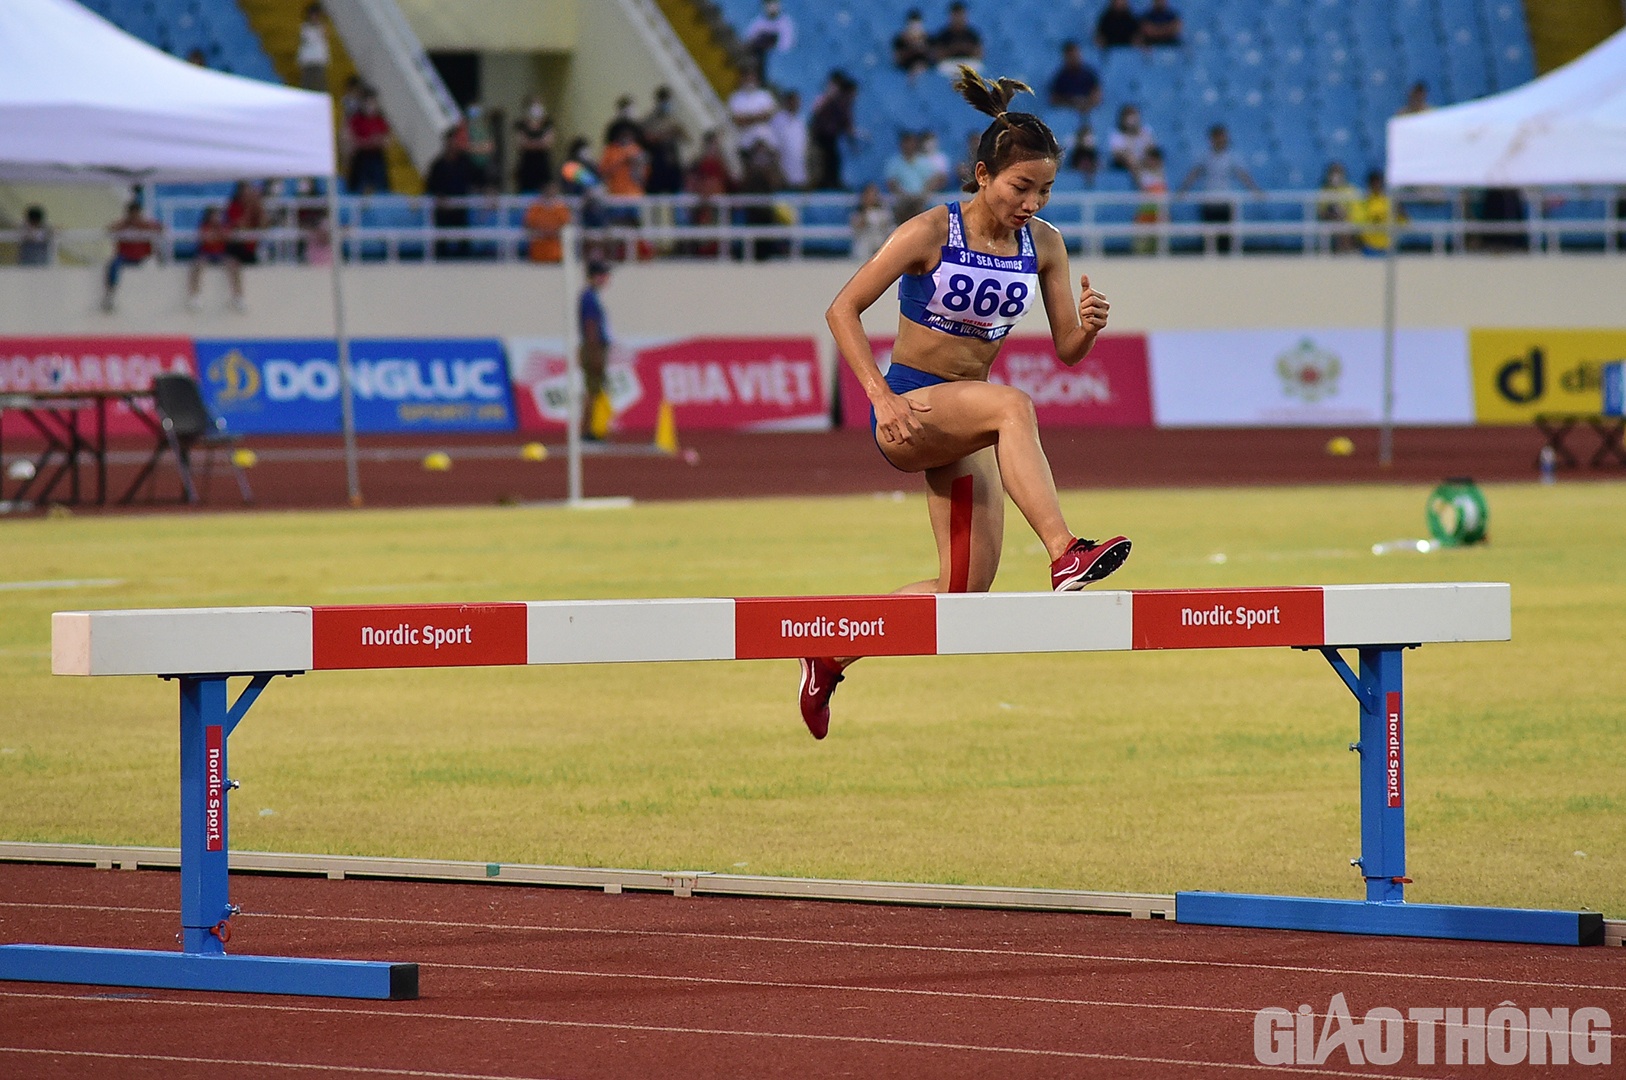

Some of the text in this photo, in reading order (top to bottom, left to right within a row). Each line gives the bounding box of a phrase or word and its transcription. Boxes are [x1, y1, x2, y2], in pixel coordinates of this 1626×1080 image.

[976, 254, 994, 268] SEA
[993, 257, 1022, 271] Games
[941, 273, 1029, 318] 868
[837, 616, 885, 642] Sport
[1235, 605, 1281, 630] Sport
[422, 624, 473, 650] Sport
[1389, 712, 1400, 758] nordic
[206, 748, 221, 841] nordic Sport
[1387, 759, 1400, 798] Sport
